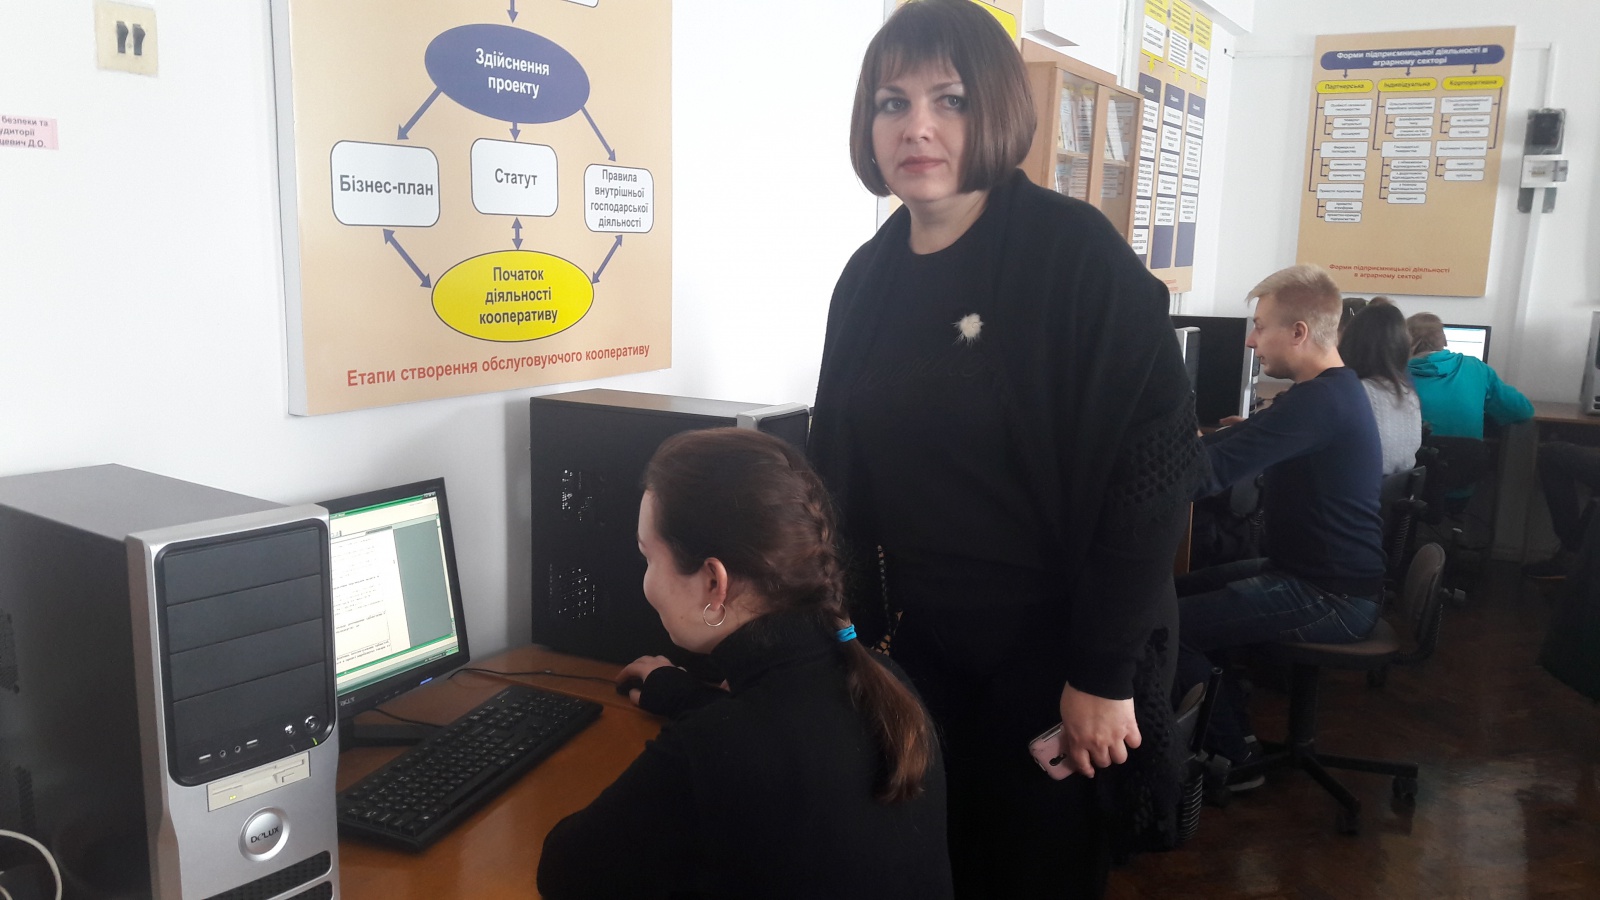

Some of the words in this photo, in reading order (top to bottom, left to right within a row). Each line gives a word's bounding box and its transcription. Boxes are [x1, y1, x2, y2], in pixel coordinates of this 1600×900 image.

[475, 47, 550, 77] Здійснення
[1372, 58, 1414, 67] аграрному
[1417, 57, 1447, 65] секторі
[488, 76, 540, 99] проекту
[1, 115, 37, 126] безпеки
[28, 139, 47, 148] Д.О.
[494, 168, 538, 189] Статут
[601, 169, 638, 184] Правила
[339, 174, 434, 198] Бізнес-план
[594, 186, 645, 200] внутрішньої
[590, 200, 649, 216] господарської
[598, 215, 642, 229] діяльності
[493, 265, 544, 283] Початок
[1329, 263, 1352, 271] Форми
[1353, 265, 1411, 273] підприємницької
[1412, 266, 1450, 274] діяльності
[485, 286, 552, 306] діяльності
[479, 307, 558, 326] кооперативу
[347, 368, 396, 388] Етапи
[400, 361, 478, 381] створення
[481, 349, 583, 374] обслуговуючого
[585, 343, 650, 362] кооперативу
